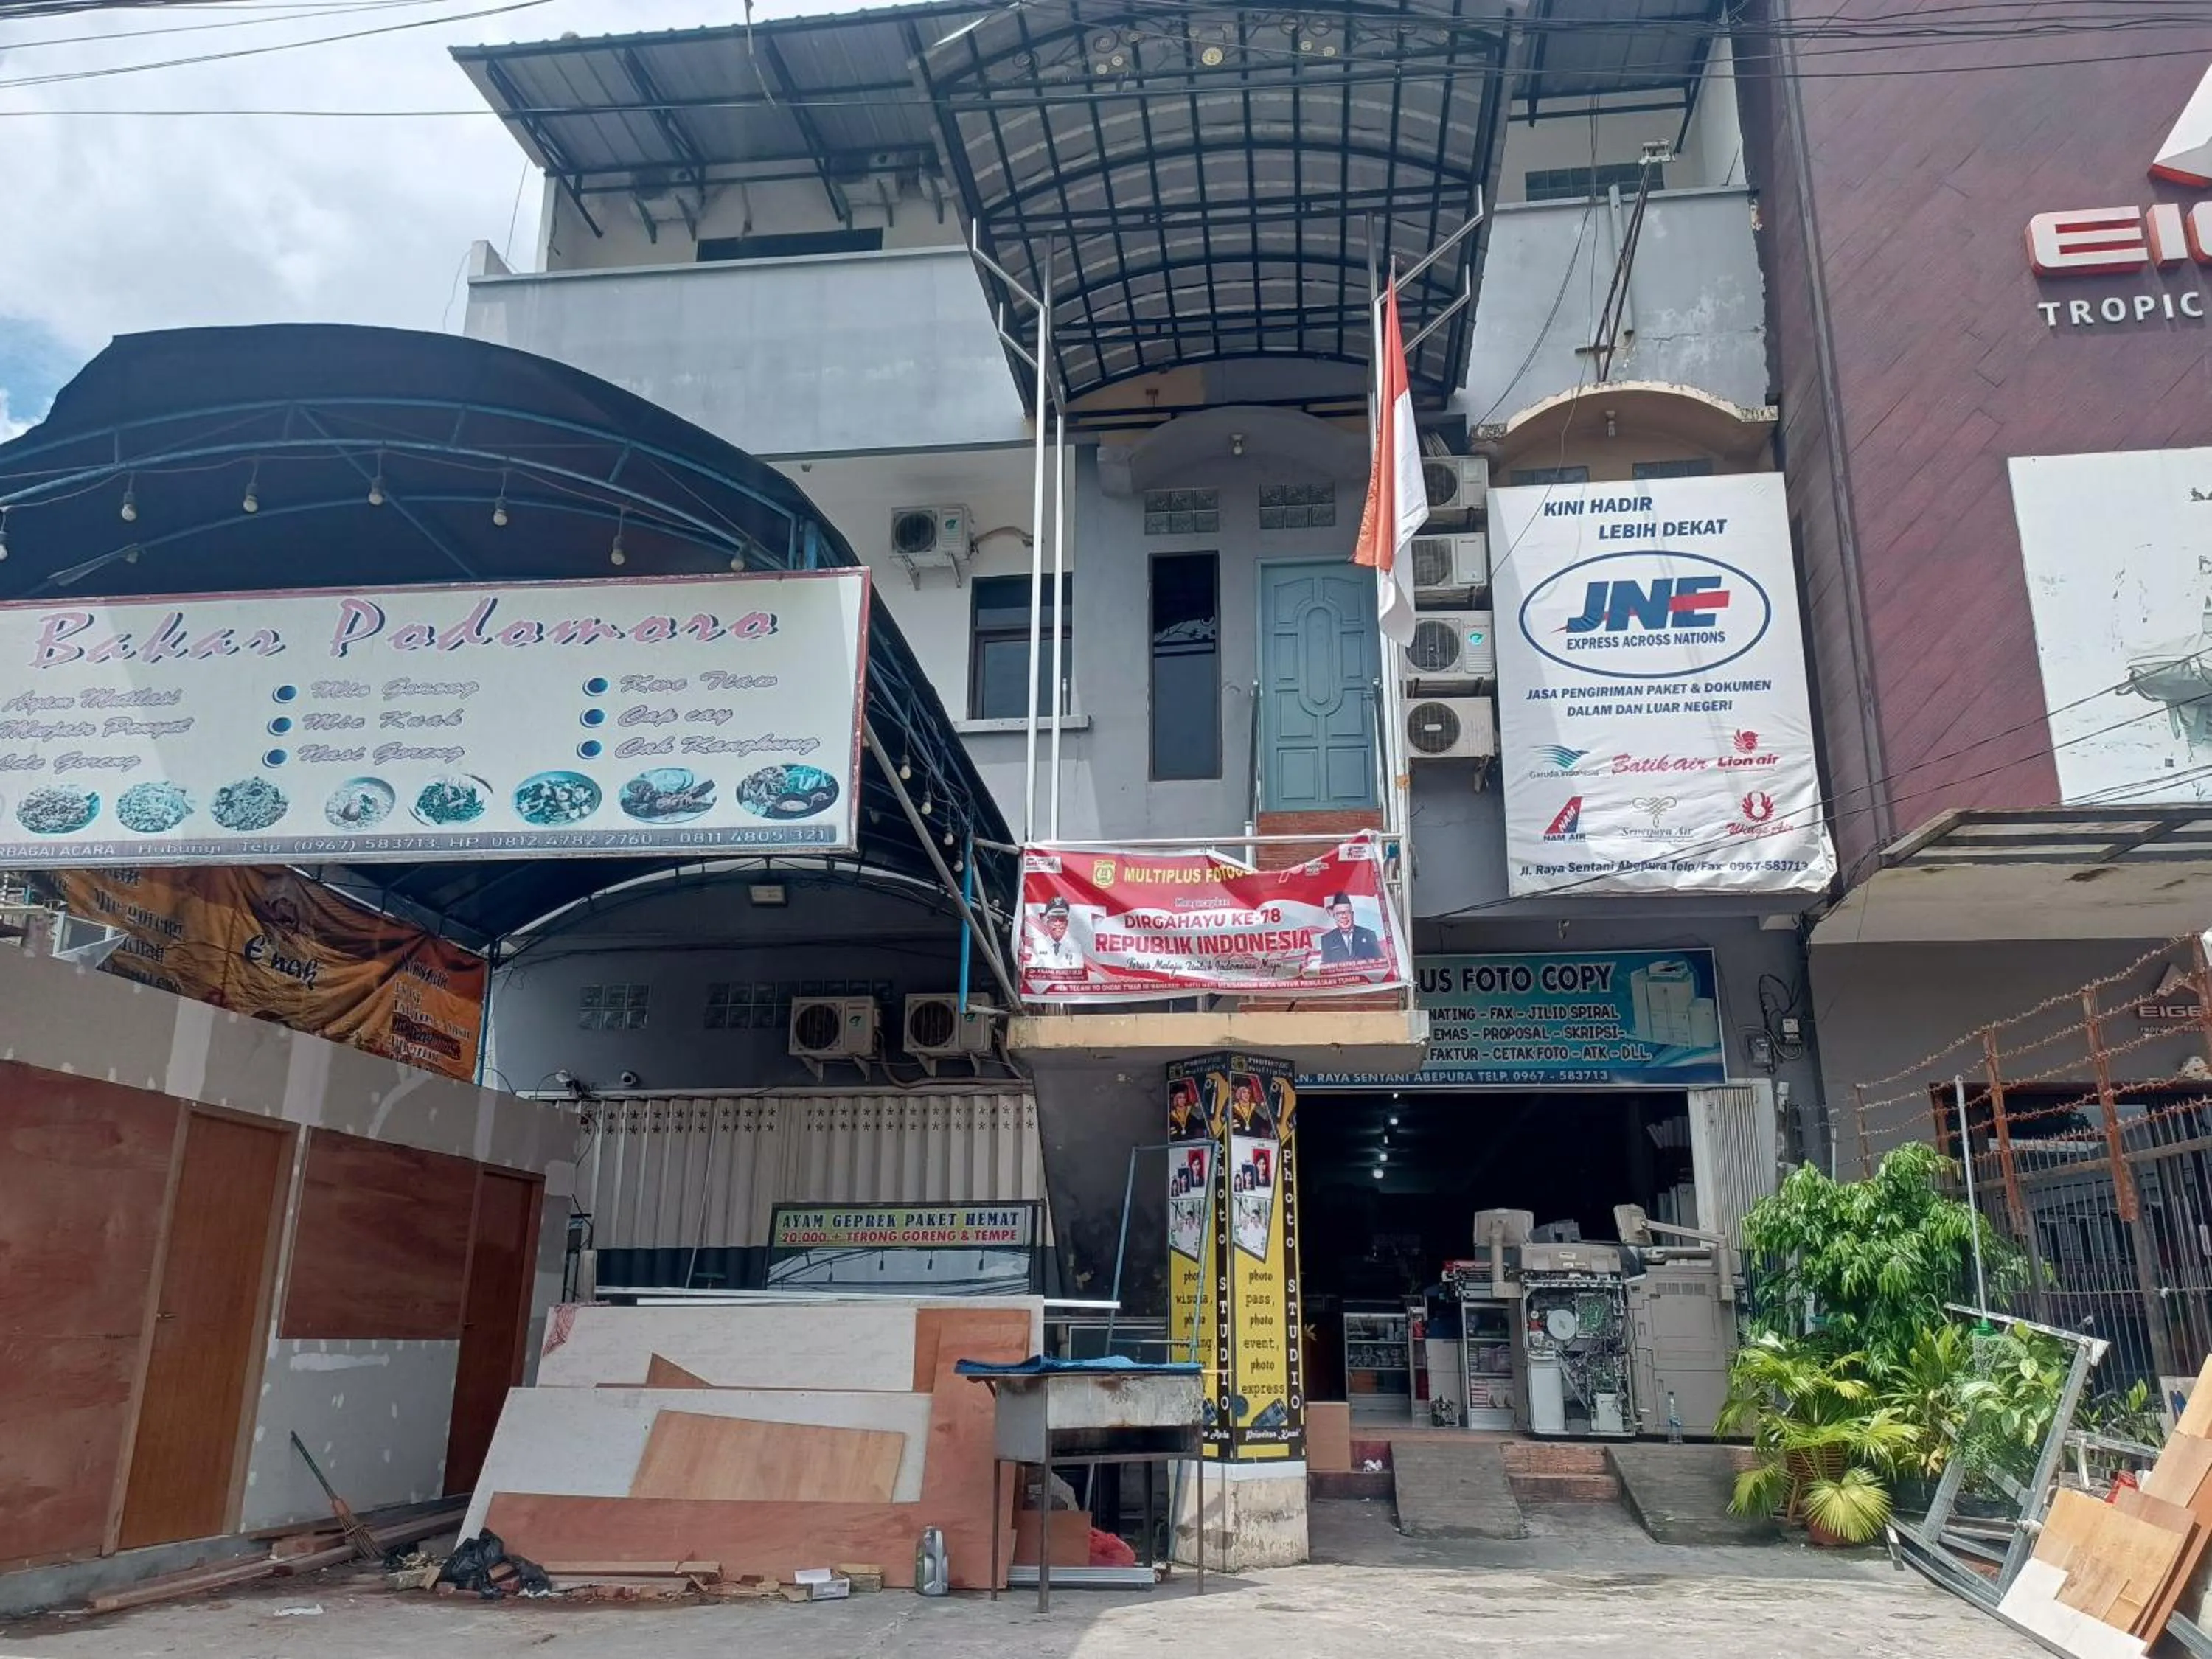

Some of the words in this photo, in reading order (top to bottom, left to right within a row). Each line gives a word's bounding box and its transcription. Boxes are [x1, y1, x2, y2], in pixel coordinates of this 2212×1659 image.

[2025, 200, 2212, 278] EI
[1544, 499, 1584, 517] KINI
[1590, 496, 1653, 514] HADIR
[1599, 521, 1657, 540] LEBIH
[1662, 518, 1728, 538] DEKAT
[1565, 575, 1731, 633] JNE
[28, 611, 288, 669] Bakar
[1566, 634, 1619, 650] EXPRESS
[1622, 633, 1671, 649] ACROSS
[1673, 630, 1726, 647] NATIONS
[1526, 686, 1558, 700] JASA
[1561, 684, 1644, 700] PENGIRIMAN
[1646, 682, 1687, 695] PAKET
[1691, 682, 1702, 694] &
[1704, 679, 1772, 694] DOKUMEN
[1567, 703, 1613, 717] DALAM
[1616, 703, 1643, 715] DAN
[1646, 702, 1680, 714] LUAR
[1683, 700, 1733, 713] NEGERI
[1717, 755, 1753, 768] Lion
[1756, 753, 1780, 765] air
[1543, 834, 1566, 842] NAM
[1568, 832, 1587, 841] AIR
[59, 844, 116, 857] ACARA
[1123, 866, 1202, 884] MULTIPLUS
[1535, 864, 1565, 876] Raya
[1568, 861, 1615, 874] Sentani
[1124, 911, 1227, 930] DIRGAHAYU
[1231, 908, 1281, 927] KE-78
[1093, 931, 1194, 956] REPUBLIK
[1196, 927, 1315, 956] INDONESIA
[1414, 966, 1453, 993] US
[1461, 964, 1533, 993] FOTO
[1542, 964, 1614, 993] COPY
[1429, 1007, 1476, 1023] NATING
[1489, 1006, 1516, 1021] FAX
[1528, 1006, 1568, 1021] JILID
[1570, 1004, 1618, 1020] SPIRAL
[2139, 1004, 2203, 1018] EIGE
[1482, 1027, 1549, 1042] PROPOSAL
[1430, 1047, 1478, 1062] FAKTUR
[1493, 1046, 1535, 1062] CETAK
[1536, 1046, 1569, 1061] FOTO
[1582, 1046, 1608, 1060] ATK
[1317, 1074, 1351, 1083] RAYA
[1350, 1073, 1410, 1083] SENTANI
[1413, 1071, 1474, 1083] ABEPURA
[1478, 1071, 1508, 1082] TELP.
[1512, 1071, 1543, 1082] 0967
[1559, 1070, 1608, 1082] 583713
[782, 1214, 824, 1228] AYAM
[832, 1213, 897, 1228] GEPREK
[905, 1212, 958, 1227] PAKET
[964, 1211, 1020, 1226] HEMAT
[782, 1231, 827, 1243] 20.000
[847, 1231, 897, 1242] TERONG
[902, 1230, 957, 1242] GORENG
[961, 1230, 970, 1241] &
[974, 1229, 1018, 1242] TEMPE
[1248, 1268, 1274, 1285] photo
[1245, 1294, 1276, 1308] pass,
[1249, 1312, 1274, 1329] photo
[1242, 1338, 1280, 1352] event,
[1288, 1279, 1300, 1411] STUDIO
[1250, 1357, 1276, 1374] photo
[1241, 1383, 1286, 1399] express
